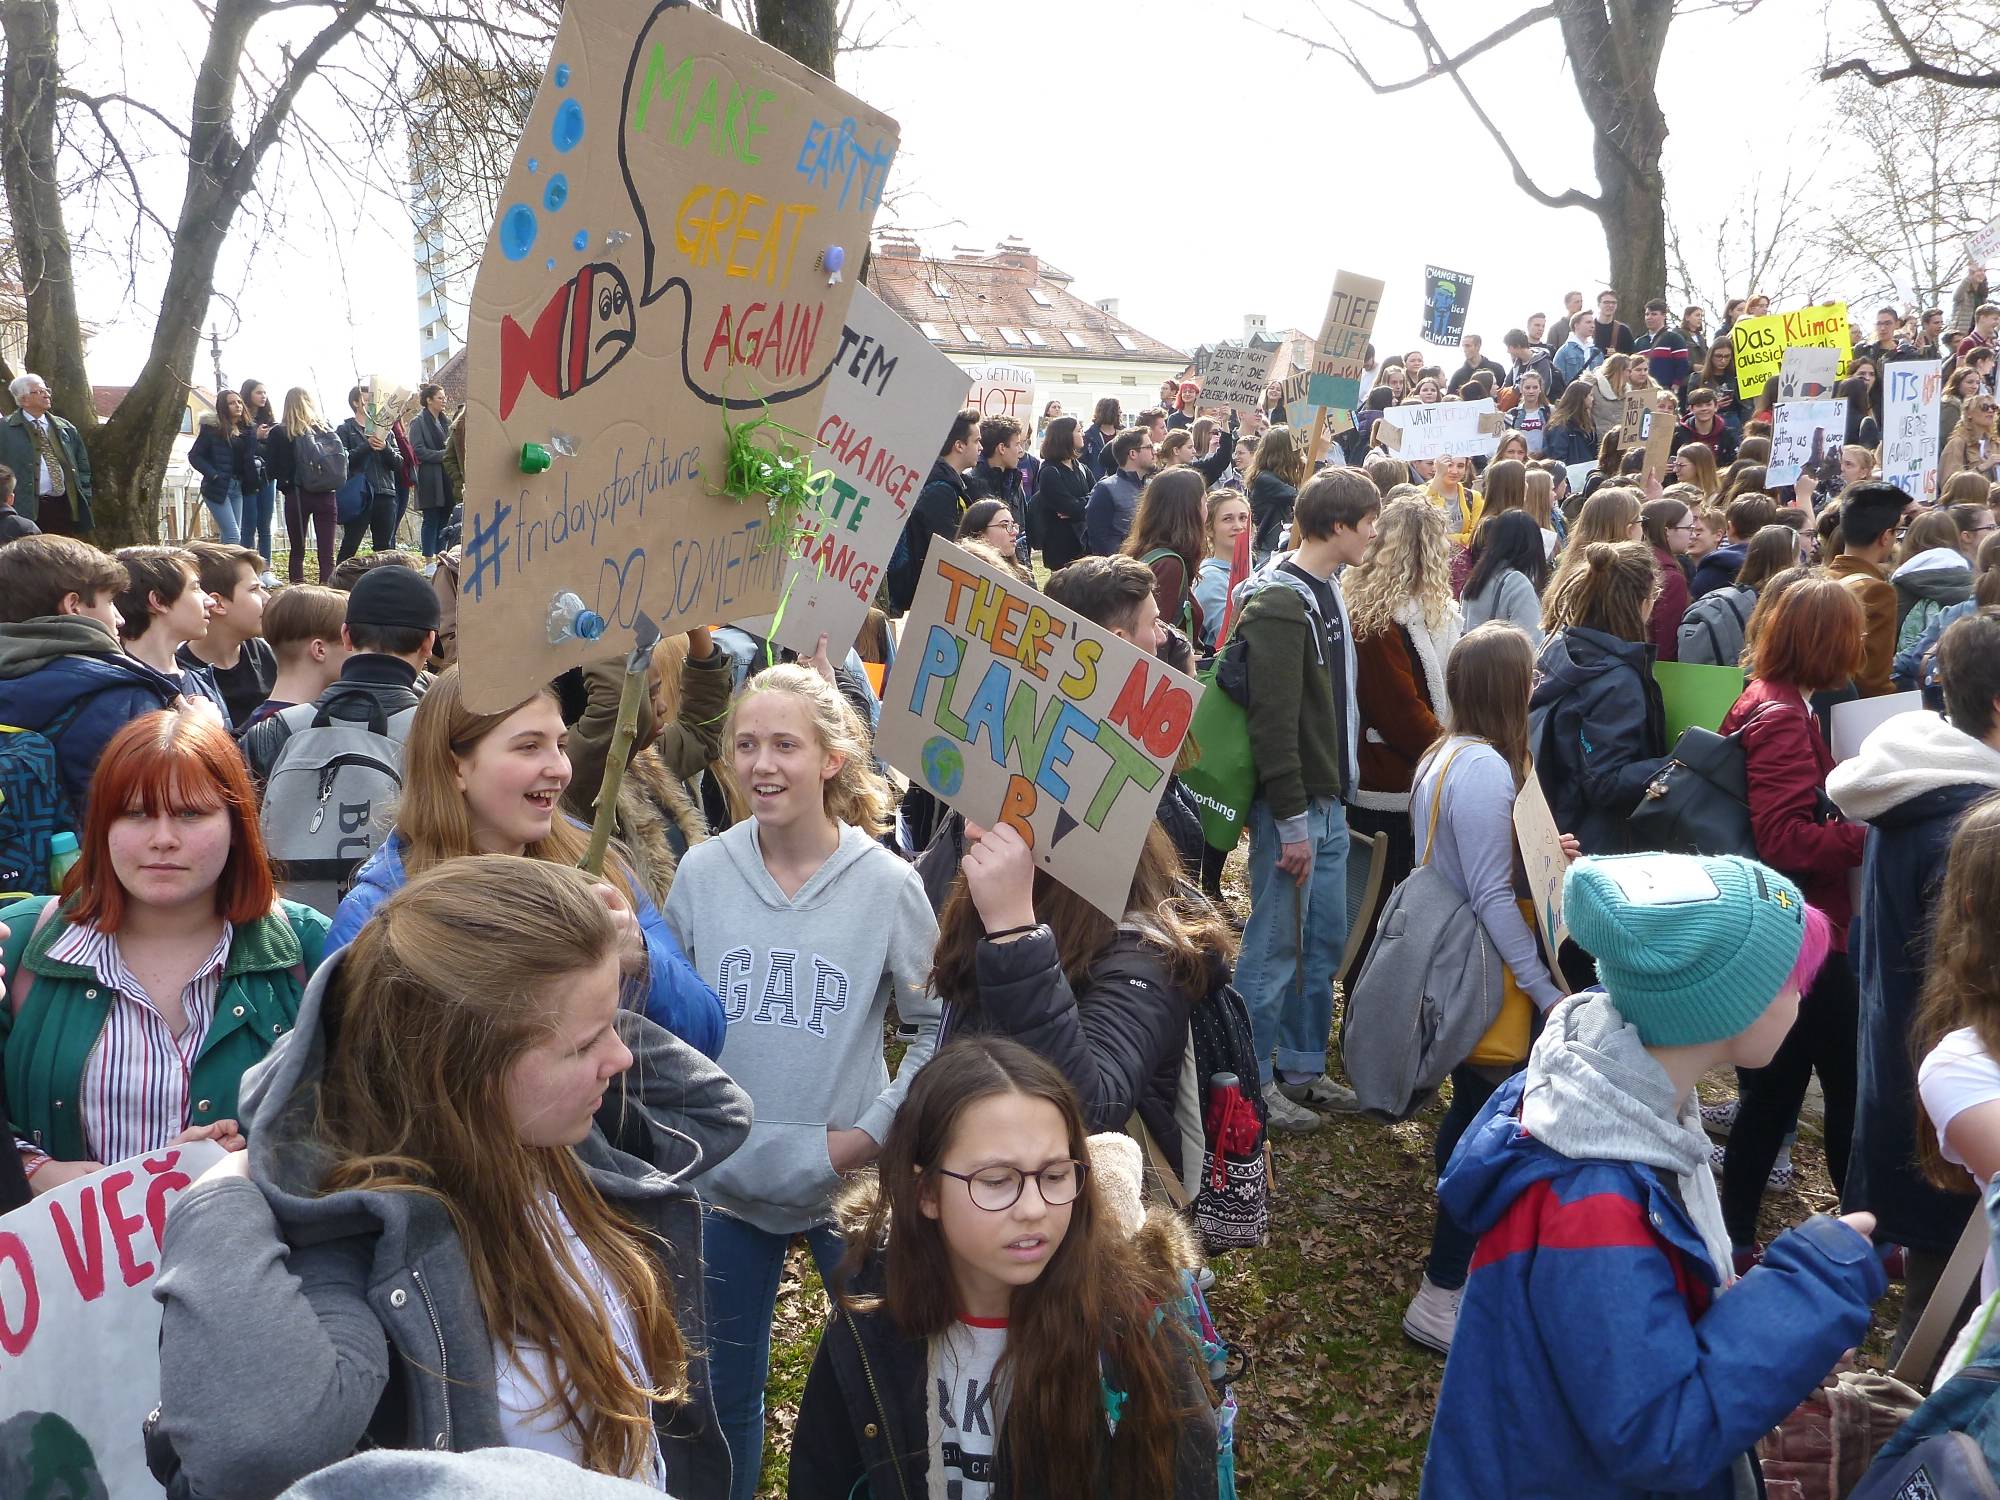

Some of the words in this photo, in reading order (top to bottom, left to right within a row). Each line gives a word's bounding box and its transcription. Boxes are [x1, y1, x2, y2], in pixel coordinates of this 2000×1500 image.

[633, 40, 778, 165] MAKE
[795, 116, 894, 213] EARTH
[674, 183, 817, 292] GREAT
[1426, 267, 1456, 281] CHANGE
[1458, 275, 1472, 285] THE
[1333, 291, 1379, 328] TIEF
[704, 301, 823, 377] AGAIN
[1323, 326, 1370, 359] LUFT
[1424, 331, 1458, 345] CLIMATE
[1447, 326, 1462, 334] THE
[1735, 327, 1775, 354] Das
[1783, 312, 1844, 342] Klima:
[1247, 353, 1267, 362] NICHT
[986, 367, 1032, 385] GETTING
[1206, 376, 1219, 386] WIR
[1239, 381, 1262, 393] NOCH
[1247, 367, 1265, 379] DIE
[1891, 371, 1918, 402] ITS
[966, 387, 1026, 417] HOT
[1200, 388, 1229, 401] ERLEBEN
[1409, 408, 1436, 426] WANT
[1625, 410, 1638, 426] NO
[1774, 403, 1789, 424] The
[1833, 401, 1843, 416] is
[1797, 435, 1807, 447] us
[1787, 452, 1799, 466] the
[1923, 469, 1937, 494] US
[463, 436, 700, 603] #fridaysforfuture
[793, 512, 879, 602] HANGE
[596, 547, 646, 630] DO
[938, 560, 1103, 701] THERE'S
[1108, 658, 1193, 758] NO
[908, 625, 1164, 832] PLANET
[717, 944, 849, 1039] GAP
